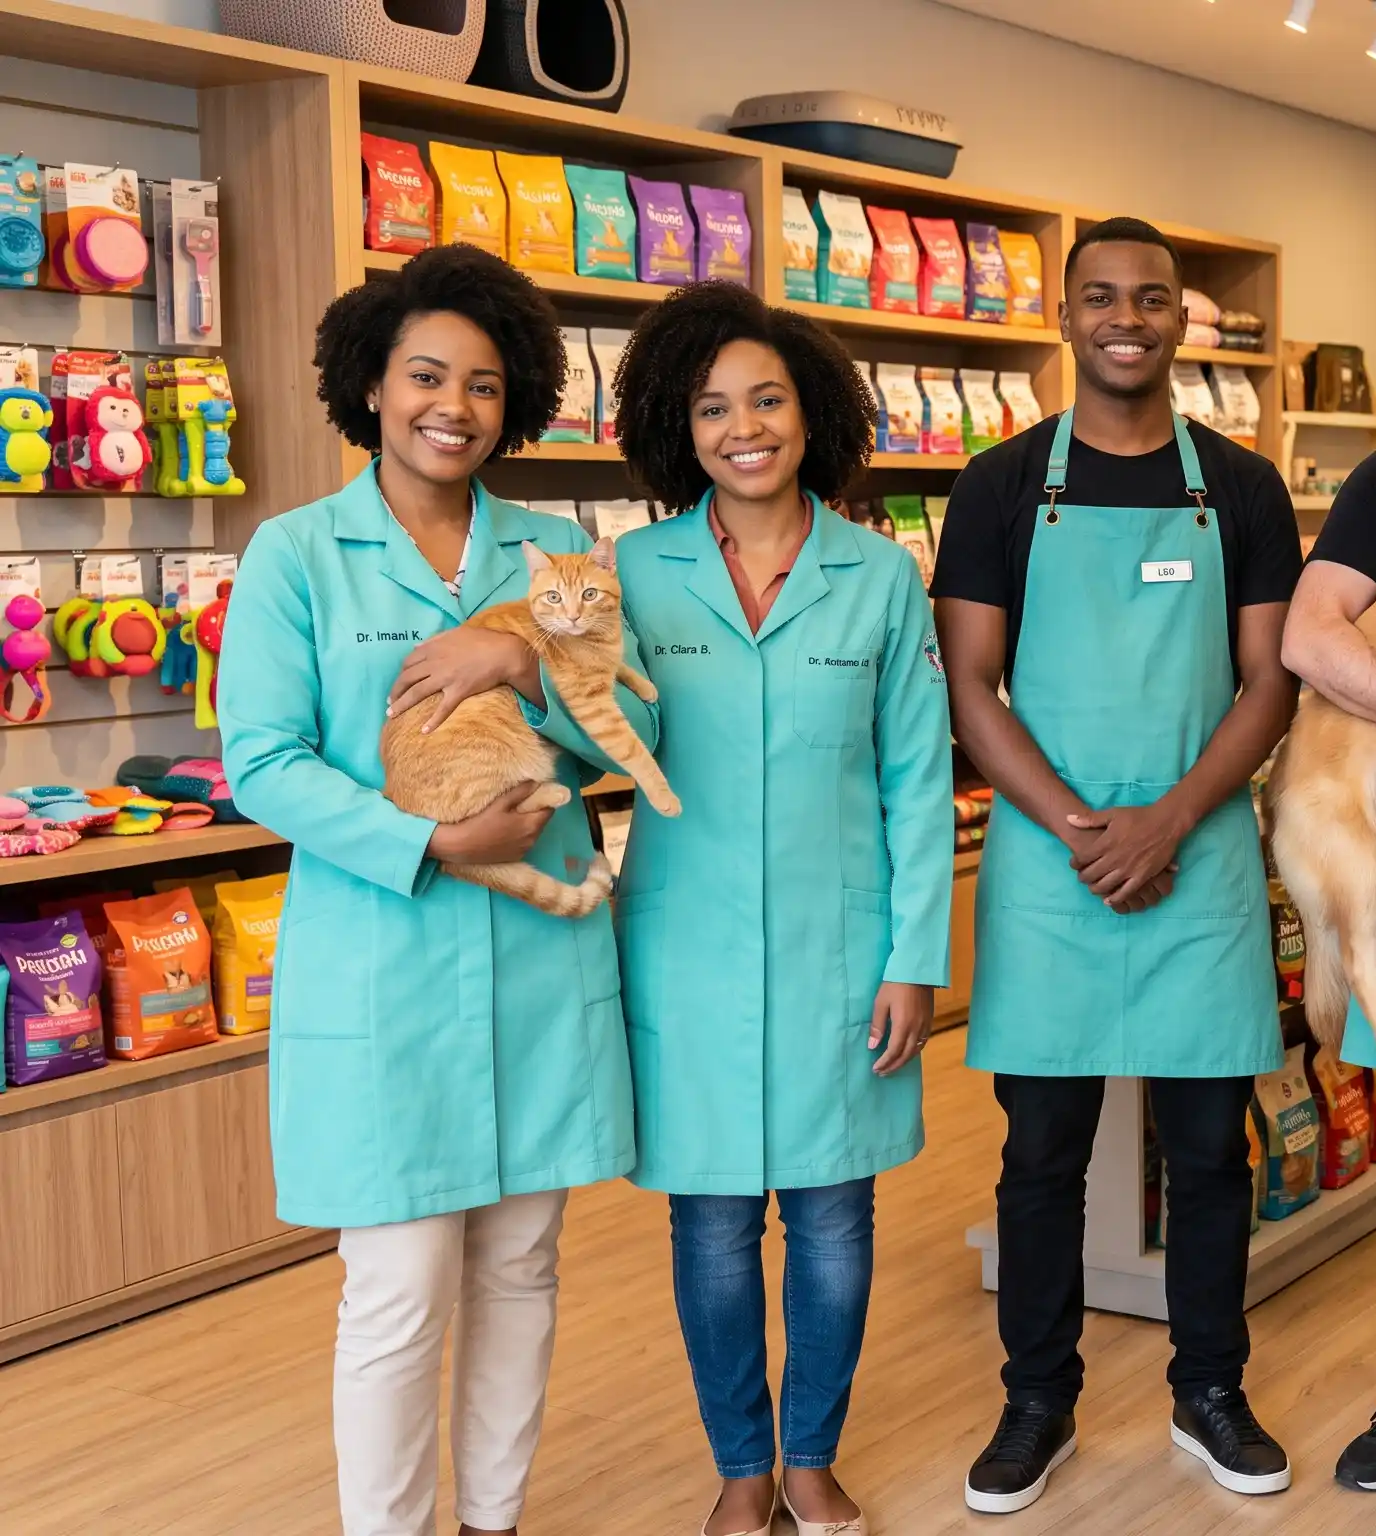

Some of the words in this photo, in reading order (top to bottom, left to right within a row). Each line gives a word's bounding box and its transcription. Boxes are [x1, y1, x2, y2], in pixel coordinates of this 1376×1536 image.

[356, 632, 373, 643] Dr.
[376, 630, 409, 641] Imani
[411, 630, 423, 641] K.
[655, 645, 667, 656] Dr.
[670, 644, 697, 655] Clara
[700, 644, 711, 655] B.
[808, 656, 821, 665] Dr.
